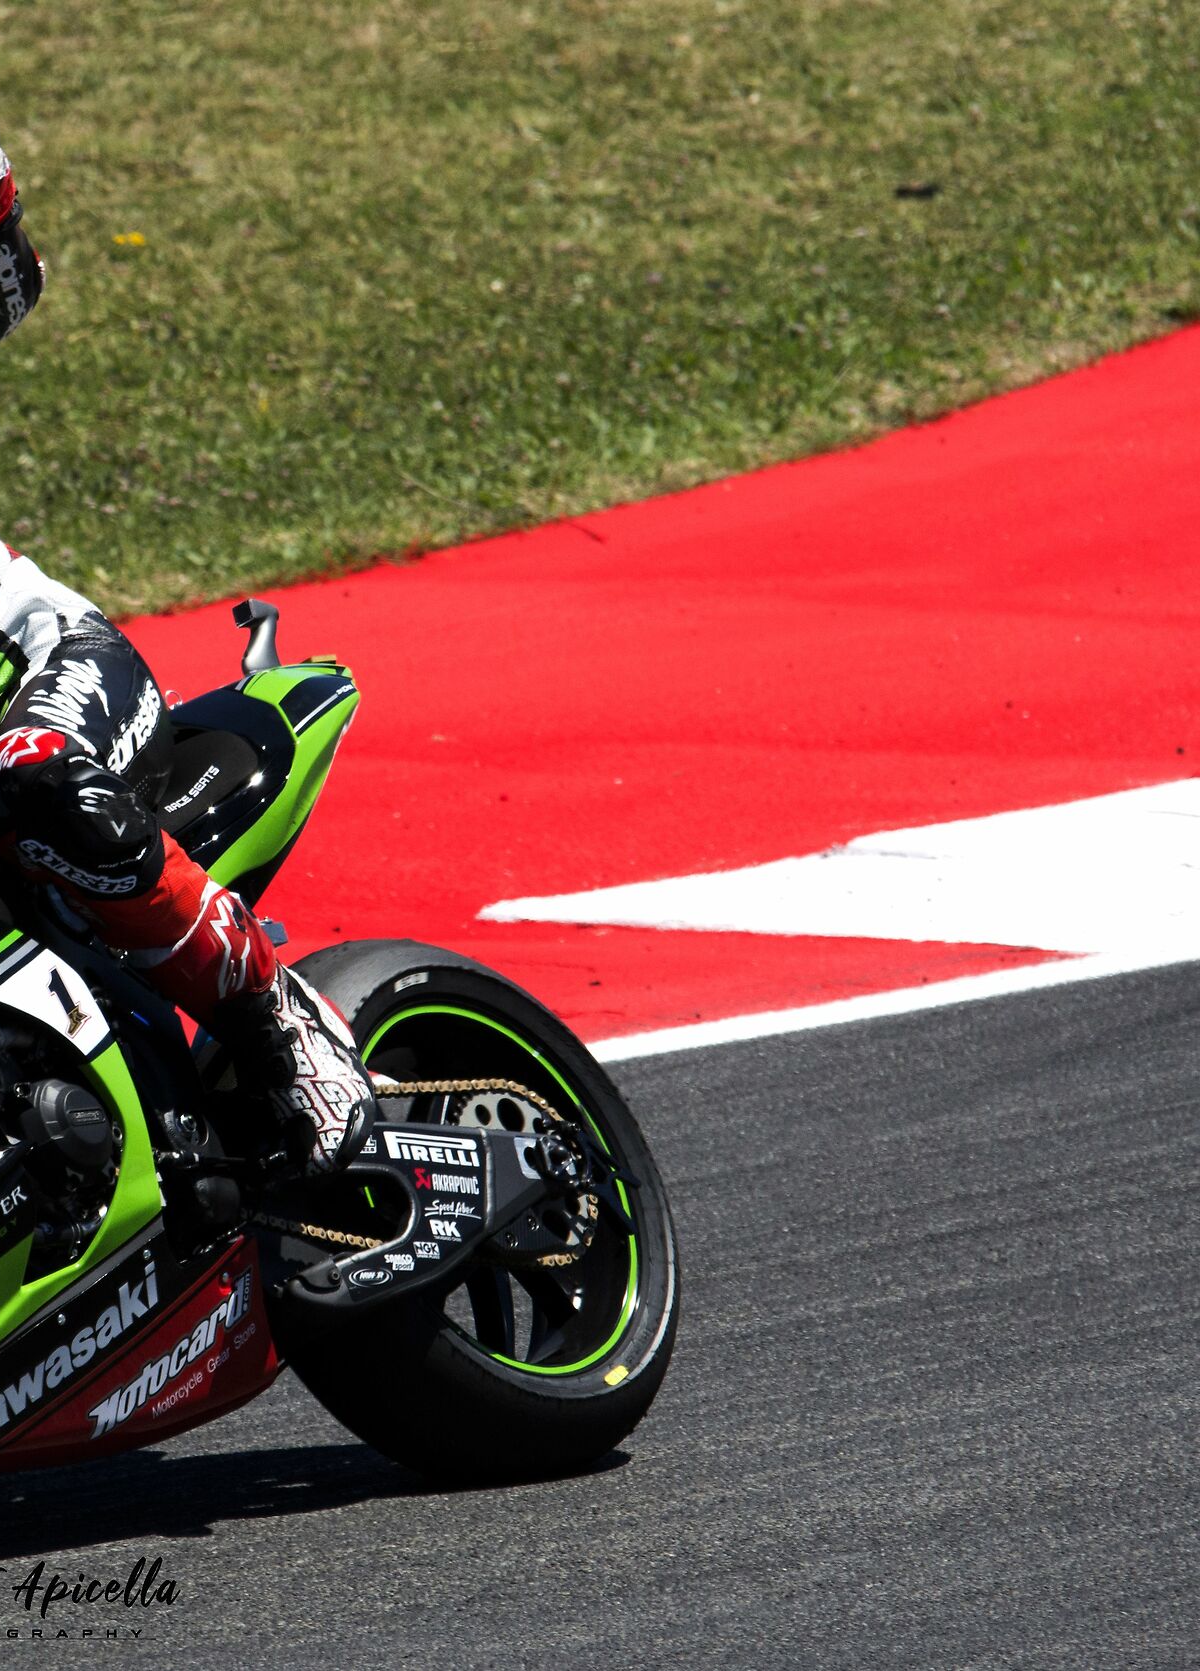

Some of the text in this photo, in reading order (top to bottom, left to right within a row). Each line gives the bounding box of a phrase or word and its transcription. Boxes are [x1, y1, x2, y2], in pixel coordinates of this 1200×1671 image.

[188, 765, 220, 798] SEATS
[383, 1131, 480, 1167] PIRELLI
[429, 1219, 462, 1238] RK
[414, 1243, 439, 1255] NGK
[152, 1323, 256, 1418] Motorcycle Gear Store
